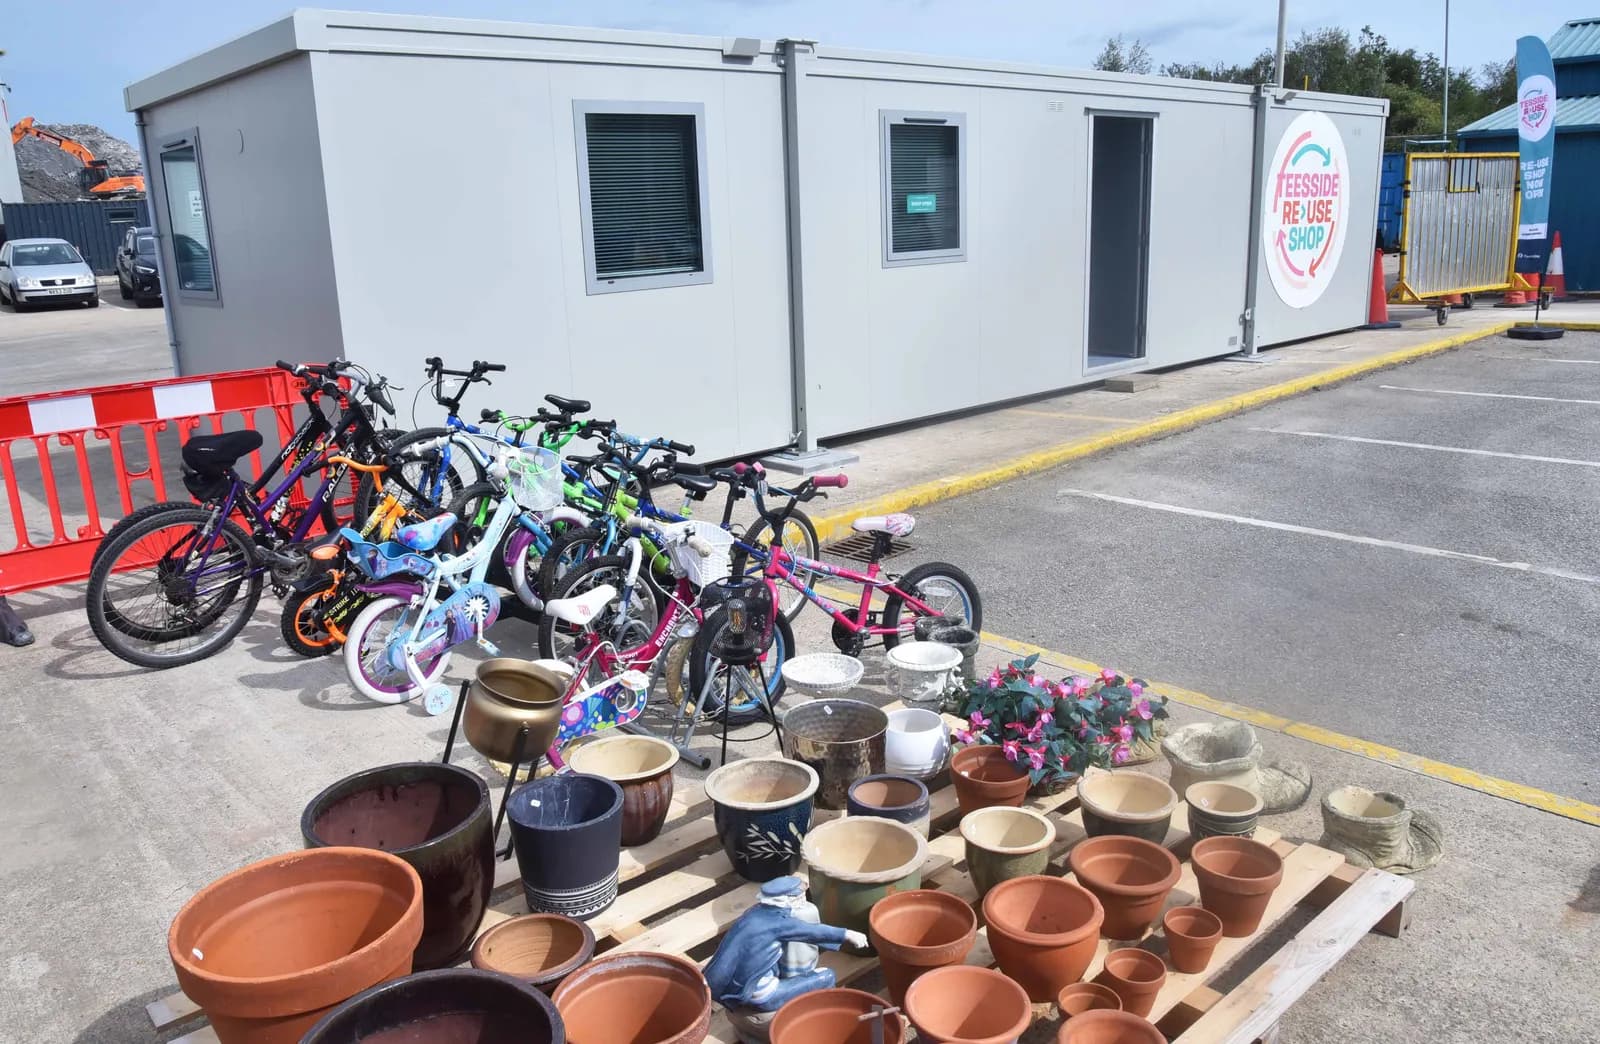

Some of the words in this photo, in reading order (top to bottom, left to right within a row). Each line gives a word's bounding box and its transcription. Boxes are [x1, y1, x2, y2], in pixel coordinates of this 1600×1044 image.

[1520, 157, 1549, 170] RE-USE
[1277, 172, 1340, 199] TEESSIDE
[1288, 226, 1324, 252] SHOP
[322, 444, 354, 502] RALEIH
